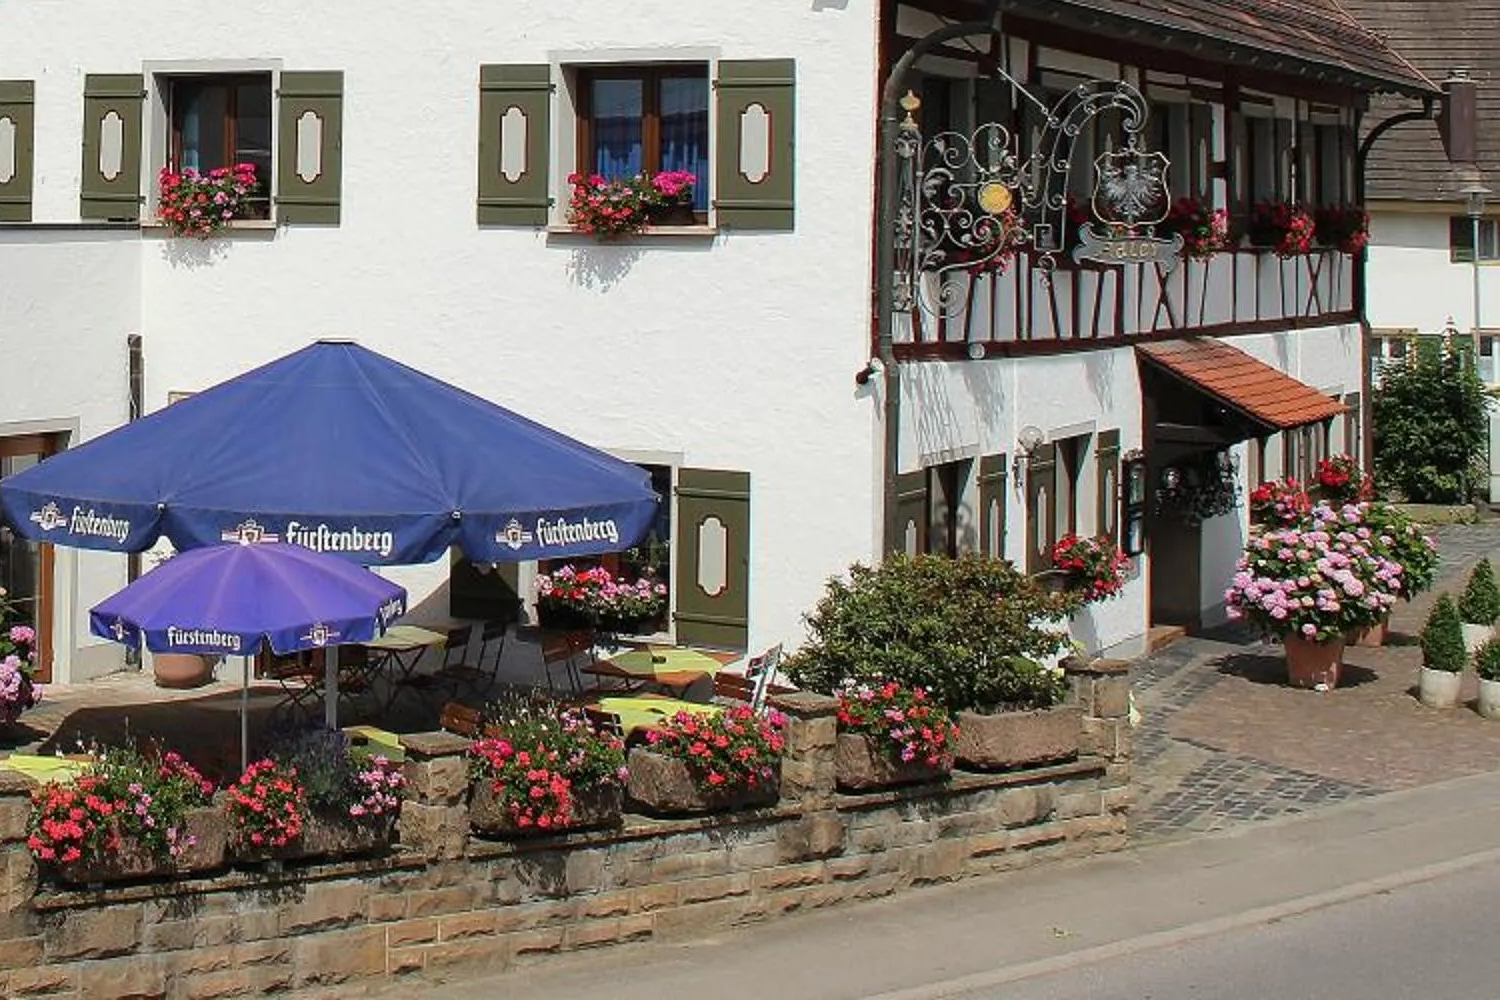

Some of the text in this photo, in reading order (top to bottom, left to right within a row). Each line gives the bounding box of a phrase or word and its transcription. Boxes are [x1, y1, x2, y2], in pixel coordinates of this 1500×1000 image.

[286, 521, 393, 557] Fürstenberg
[536, 517, 619, 547] Fürstenberg
[167, 625, 241, 651] Fürstenberg
